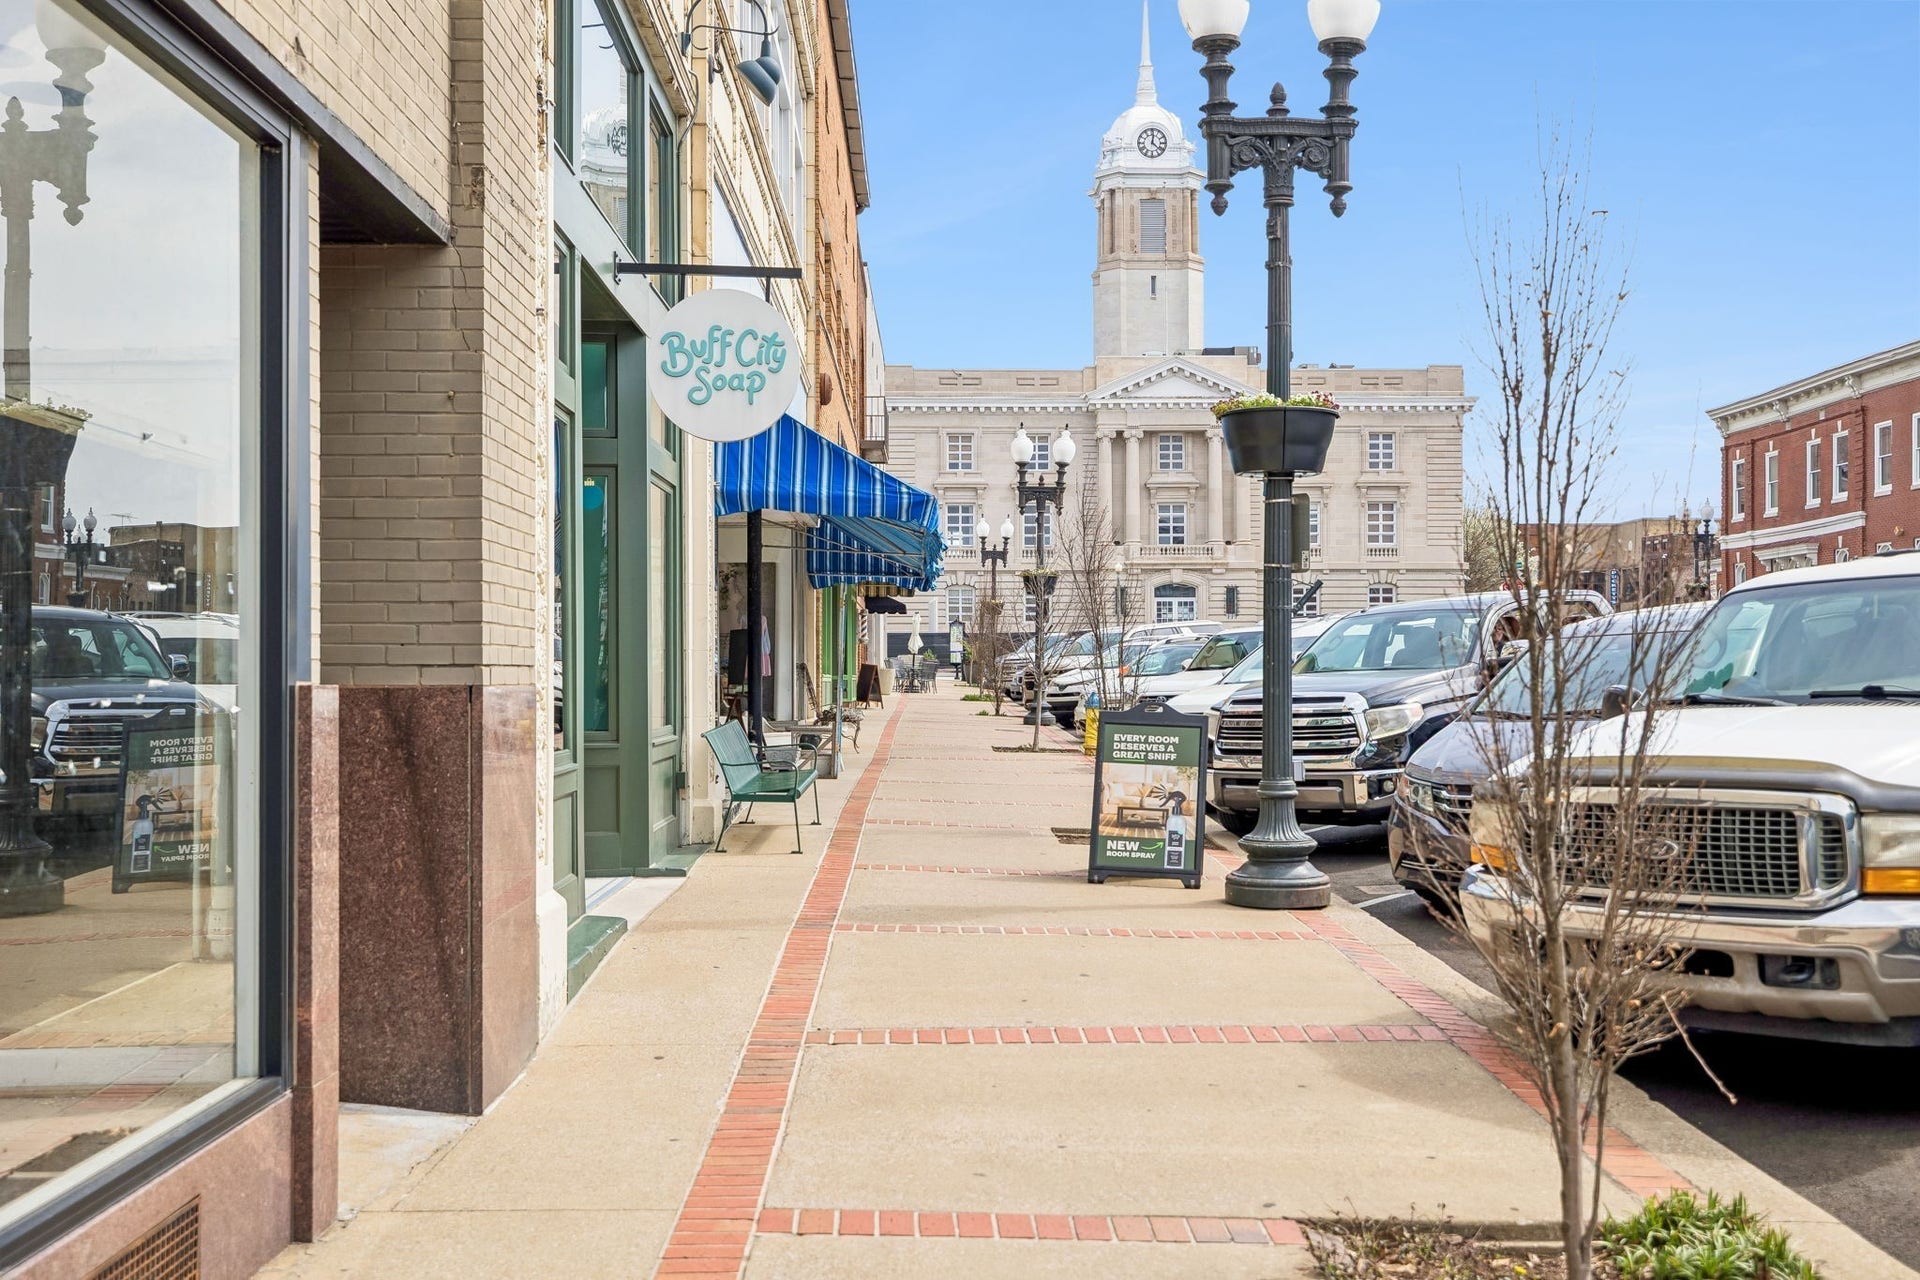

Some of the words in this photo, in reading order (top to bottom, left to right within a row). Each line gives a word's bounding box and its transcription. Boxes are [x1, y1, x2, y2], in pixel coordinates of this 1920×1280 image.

[660, 324, 734, 377] Buff
[735, 328, 787, 374] City
[687, 365, 767, 406] Soap
[1113, 733, 1146, 742] EVERY
[1147, 735, 1179, 744] ROOM
[1113, 742, 1165, 752] DESERVES
[1167, 744, 1175, 752] A
[1112, 750, 1146, 760] GREAT
[1147, 752, 1177, 761] SNIFF
[1106, 839, 1140, 851] NEW
[1106, 850, 1130, 858] ROOM
